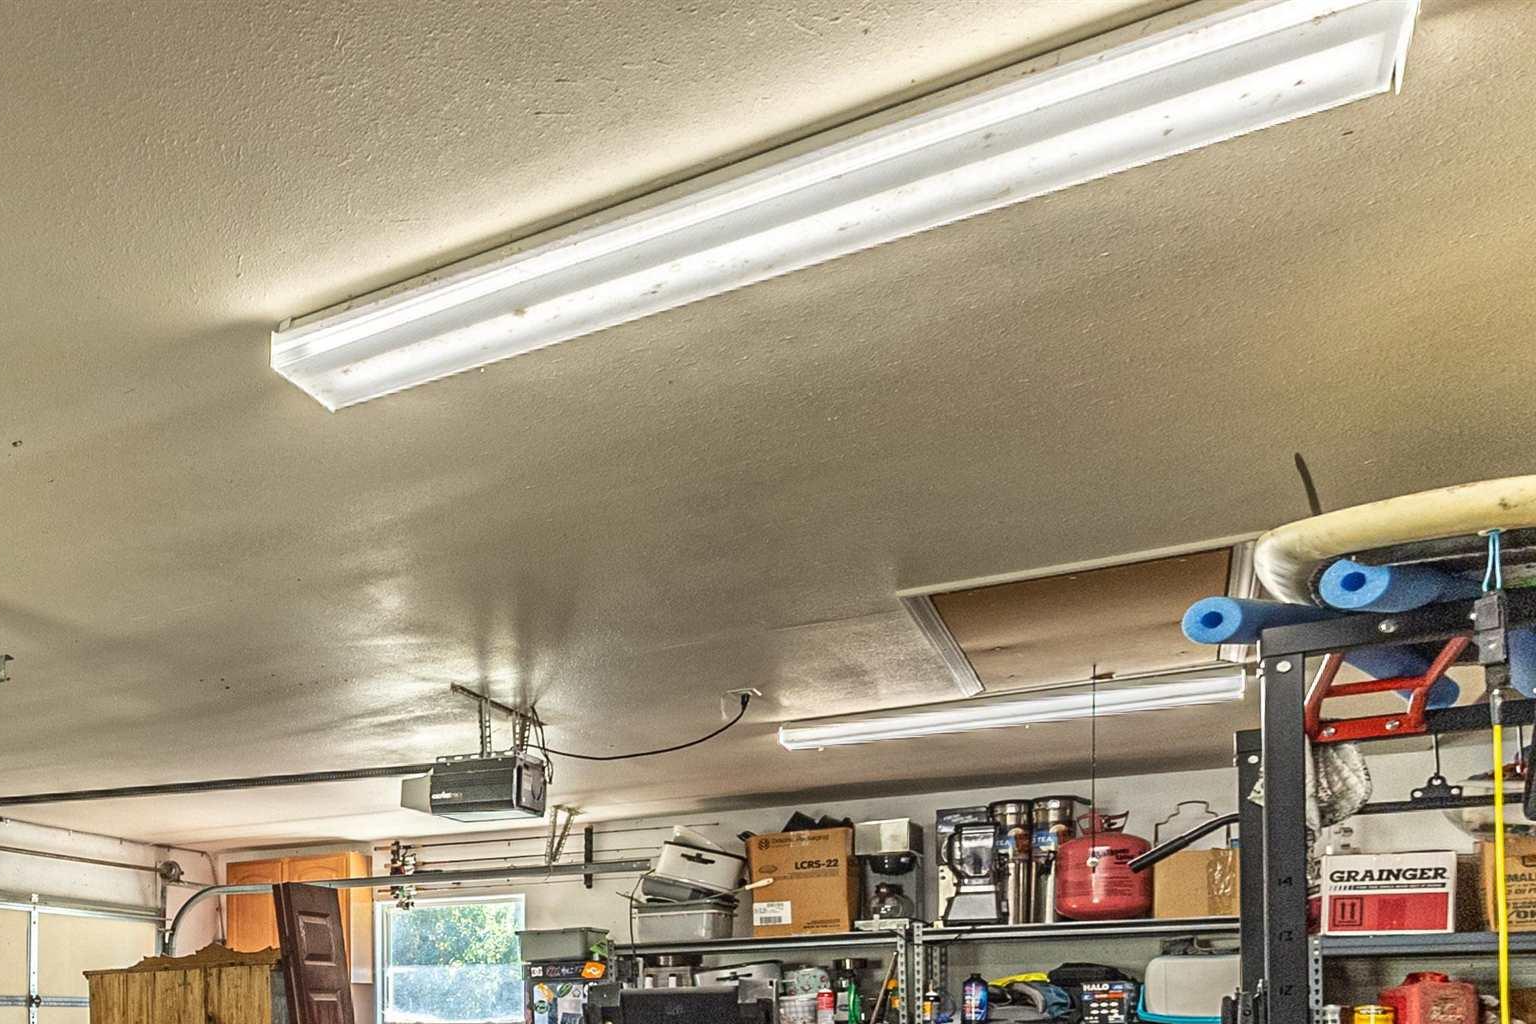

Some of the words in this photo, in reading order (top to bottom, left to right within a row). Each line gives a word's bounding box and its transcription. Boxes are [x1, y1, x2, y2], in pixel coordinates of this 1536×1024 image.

[794, 858, 839, 871] LCRS-22
[1329, 867, 1447, 883] GRAINGER
[1083, 983, 1110, 991] HALO
